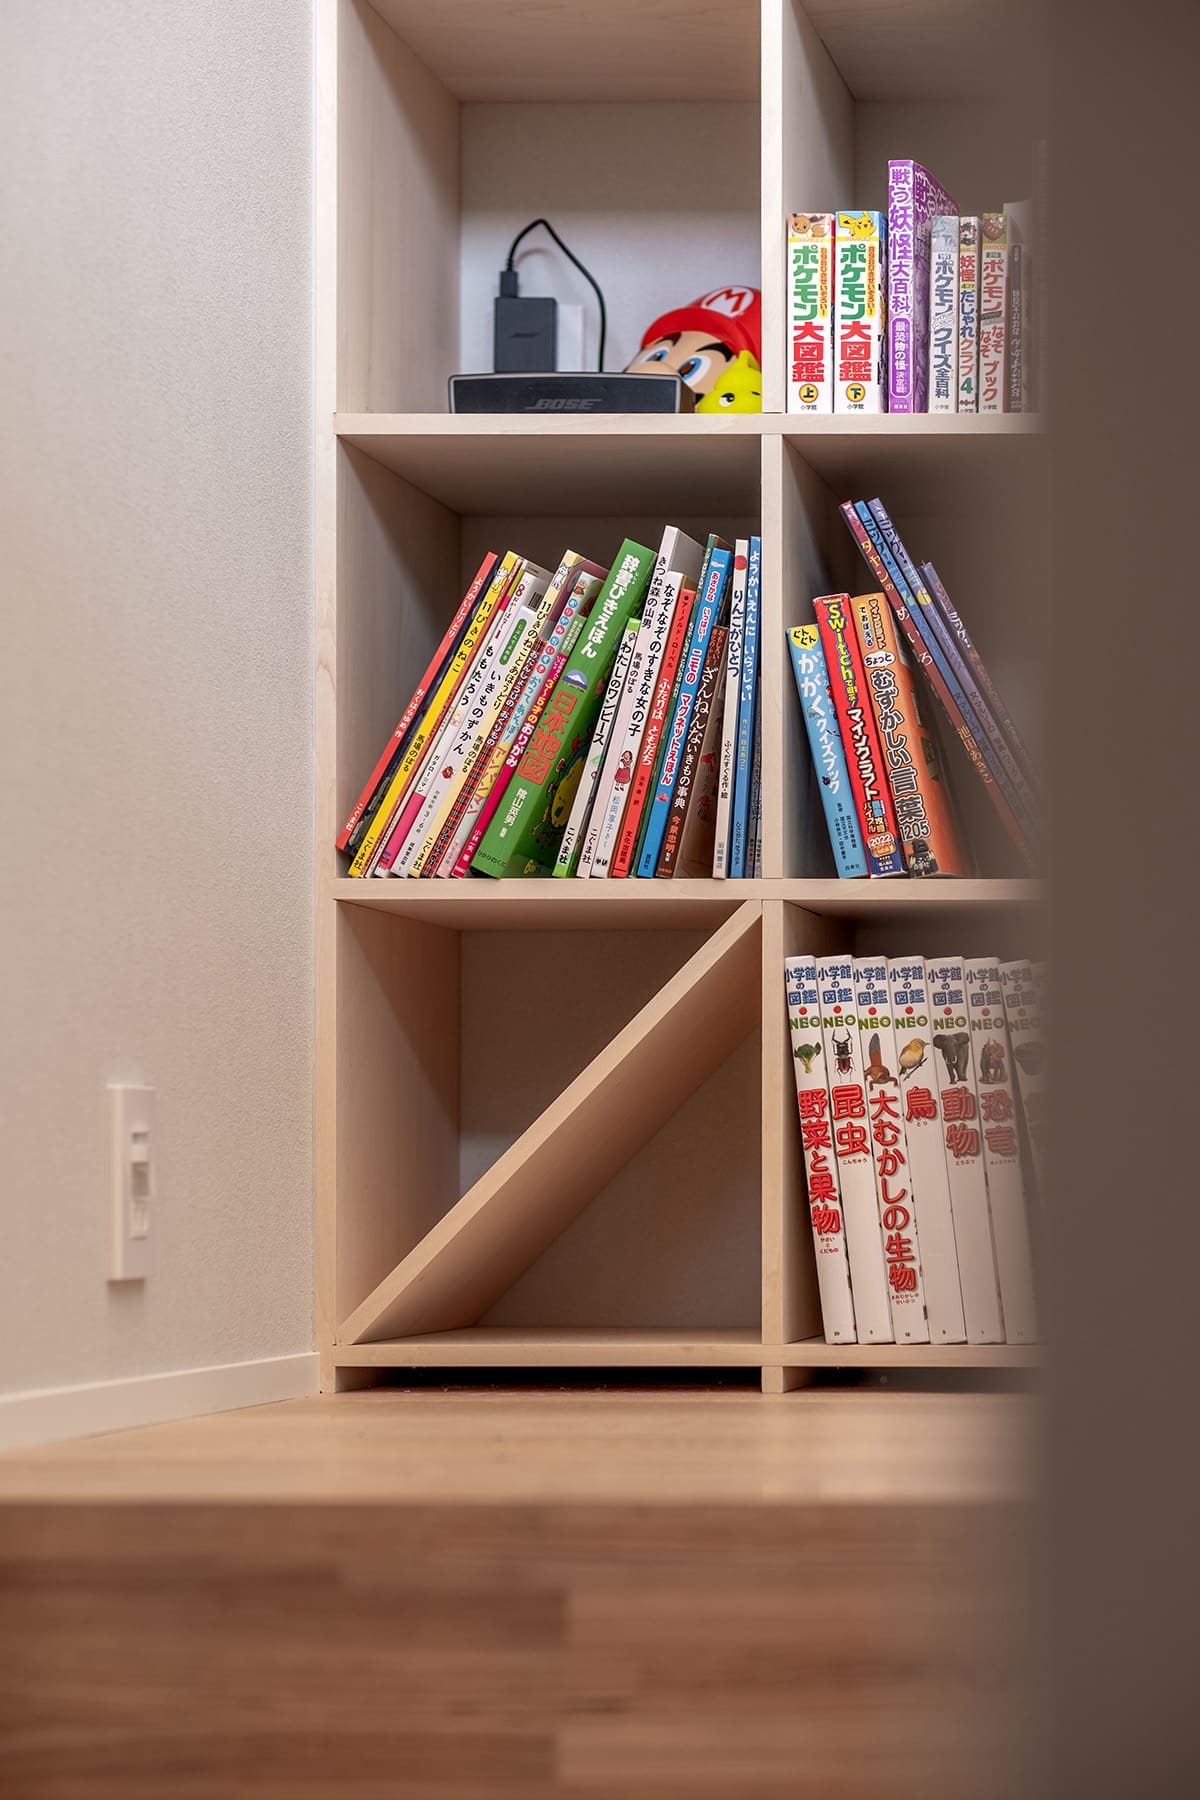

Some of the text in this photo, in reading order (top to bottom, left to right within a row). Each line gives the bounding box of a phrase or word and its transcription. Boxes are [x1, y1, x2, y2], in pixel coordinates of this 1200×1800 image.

[888, 167, 913, 313] 戦う妖怪大百科
[706, 289, 744, 313] M
[934, 260, 954, 316] ポケモン
[983, 259, 1004, 312] ポケモン
[792, 244, 825, 382] ポケモン大図鑑
[839, 243, 872, 381] ポケモン大図鑑
[933, 328, 952, 399] クイズ全百科
[983, 361, 1000, 402] ブック
[525, 399, 602, 410] BOSE
[803, 387, 814, 398] 上
[850, 387, 861, 399] 下
[641, 556, 668, 629] きつね森の山男
[704, 570, 720, 602] おさかな
[445, 576, 483, 639] ようかいしりとり
[741, 550, 760, 701] ようかいえんに いらっしゃい
[450, 600, 493, 673] 11ぴきのねこ
[727, 590, 745, 677] りんごがひとつ
[895, 606, 934, 666] めいろ
[459, 644, 495, 707] ももたろう
[490, 601, 552, 712] 11ぴきのねことあほうどり
[516, 552, 641, 786] 辞書びきえほん 日本地図
[624, 651, 643, 693] 馬場のぼる
[626, 583, 677, 738] なぞなぞのすきな女の子
[684, 648, 702, 684] ニモの
[865, 653, 893, 666] ちょっと
[452, 670, 502, 755] いきものずかん
[485, 650, 539, 746] おたんじょうびの おくりもの
[592, 640, 633, 746] わたしのワンピース
[640, 677, 672, 767] ふたりは ともだち
[660, 693, 692, 785] マグネットえほん
[673, 664, 718, 809] ざんねんないきもの事典
[401, 733, 426, 773] 馬場のぼる
[459, 734, 485, 774] 馬場のぼる
[848, 708, 879, 801] マインクラフト
[870, 669, 926, 825] むずかしい言葉
[900, 820, 931, 841] 1205
[464, 746, 506, 818] アンパンマン
[353, 835, 375, 869] こぐま社
[411, 835, 434, 871] こぐま社
[558, 827, 576, 864] こぐま社
[582, 827, 599, 864] こぐま社
[870, 835, 892, 847] 2022
[785, 966, 816, 982] 小学館
[818, 965, 852, 981] 小学館
[853, 967, 887, 983] 小学館
[890, 966, 923, 982] 小学館
[928, 967, 962, 983] 小学館
[966, 967, 1000, 984] 小学館
[789, 989, 818, 1006] 図鑑
[823, 988, 853, 1004] 図鑑
[858, 989, 888, 1006] 図鑑
[895, 989, 925, 1005] 図鑑
[933, 989, 964, 1006] 図鑑
[971, 990, 1001, 1007] 図鑑
[790, 1016, 820, 1030] NEO
[823, 1015, 856, 1028] NEO
[858, 1016, 891, 1030] NEO
[895, 1015, 928, 1029] NEO
[933, 1016, 966, 1030] NEO
[971, 1018, 1004, 1032] NEO
[831, 1084, 870, 1157] 昆虫
[906, 1086, 937, 1121] 鳥
[941, 1086, 979, 1158] 動物
[981, 1090, 1017, 1156] 恐竜
[798, 1088, 841, 1235] 野菜と果物
[870, 1090, 917, 1293] 大むかしの生物
